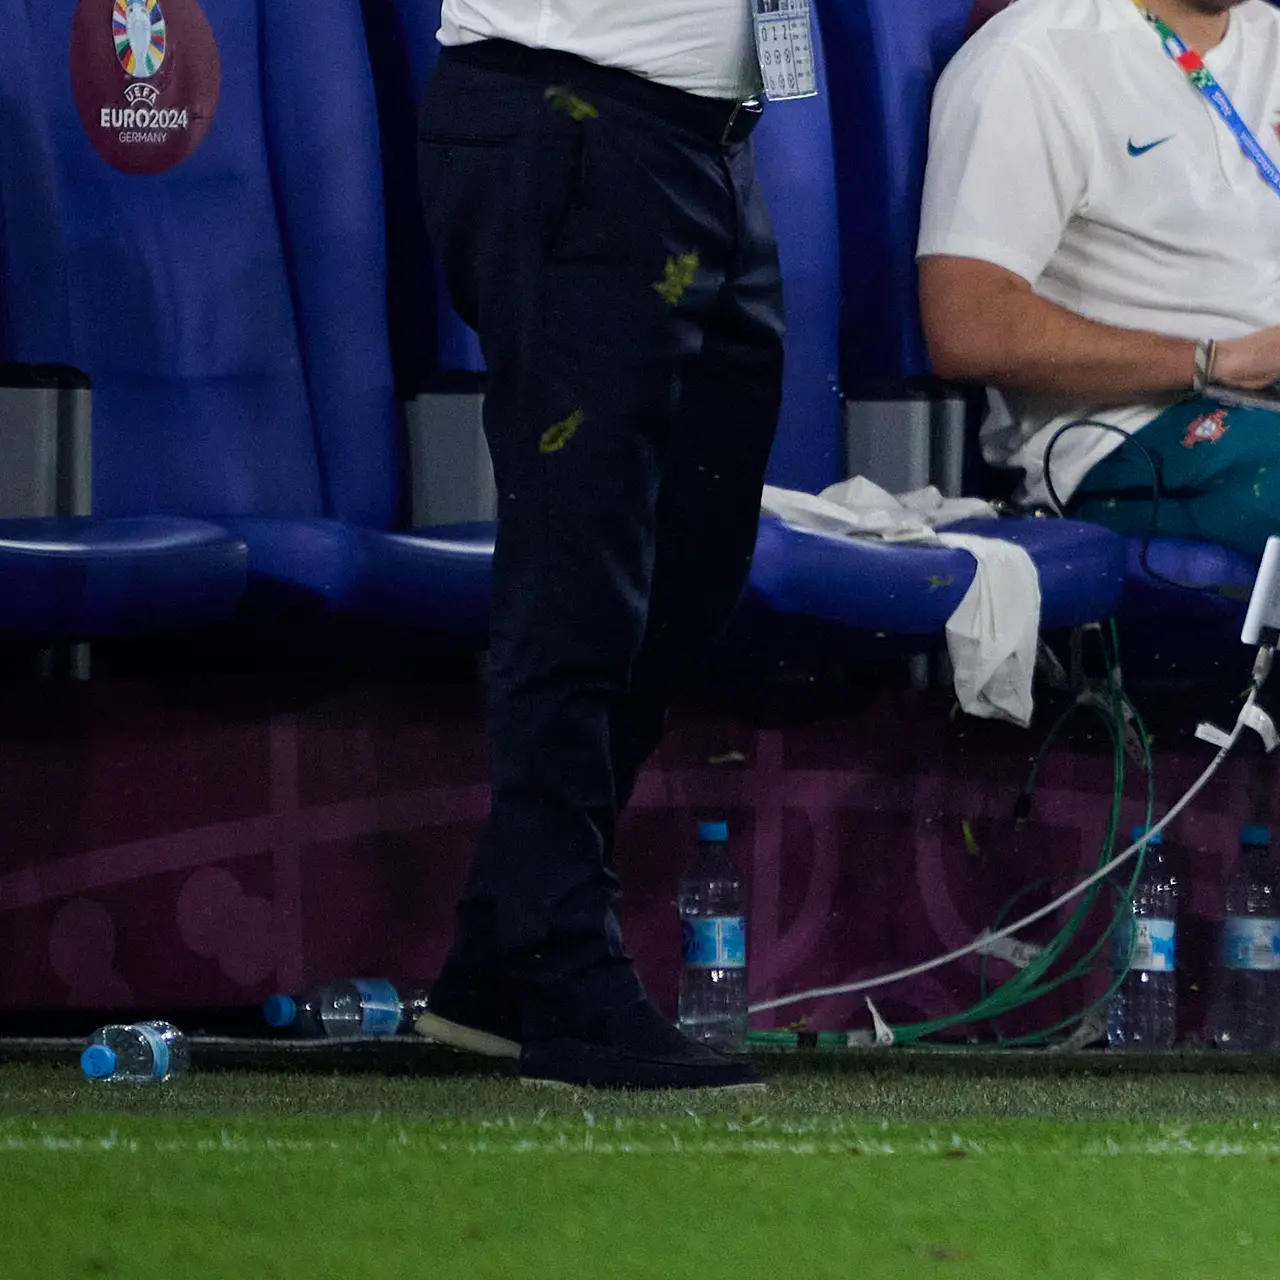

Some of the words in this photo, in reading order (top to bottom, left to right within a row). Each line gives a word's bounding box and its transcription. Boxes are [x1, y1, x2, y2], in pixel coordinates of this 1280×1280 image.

[125, 86, 158, 103] UEFA
[100, 107, 189, 129] EURO2024
[118, 131, 168, 143] GERMANY
